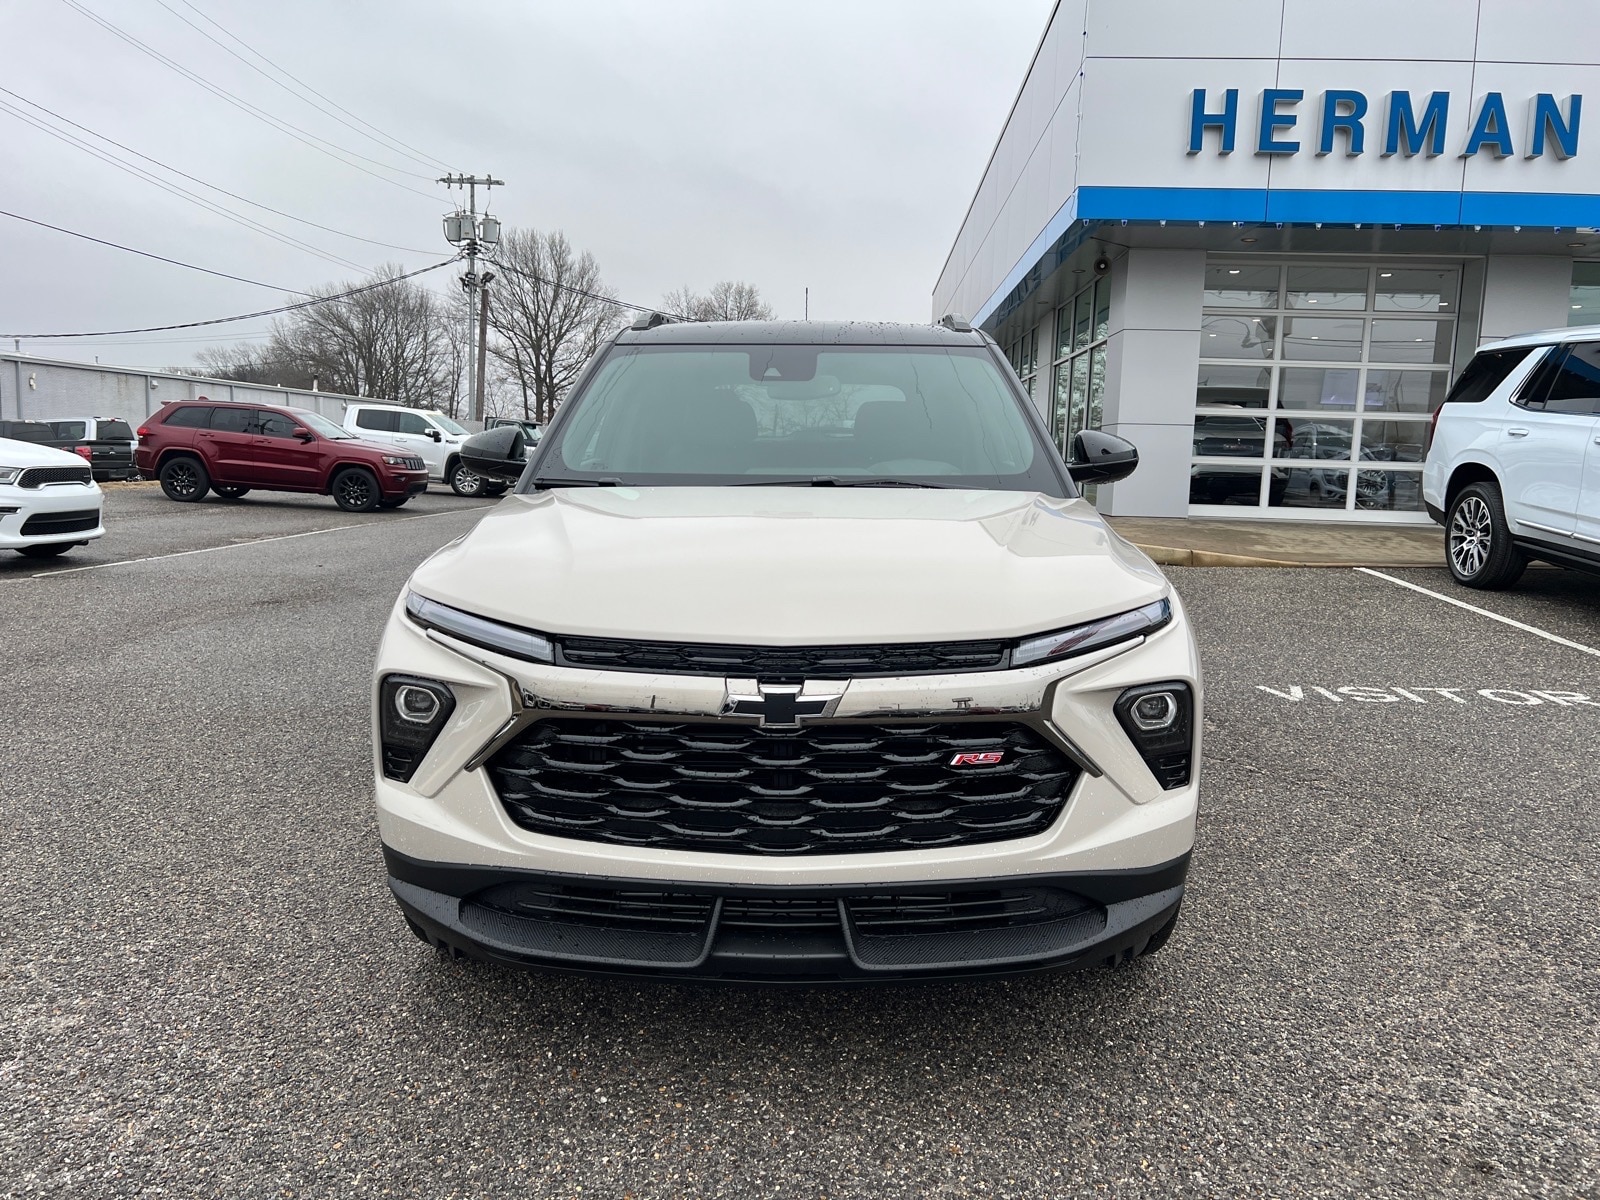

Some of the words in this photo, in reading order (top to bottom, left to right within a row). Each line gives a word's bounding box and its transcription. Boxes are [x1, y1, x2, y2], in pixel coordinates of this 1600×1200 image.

[1186, 88, 1583, 160] HERMAN
[1255, 684, 1600, 706] VISITOR
[950, 751, 1004, 766] RS
